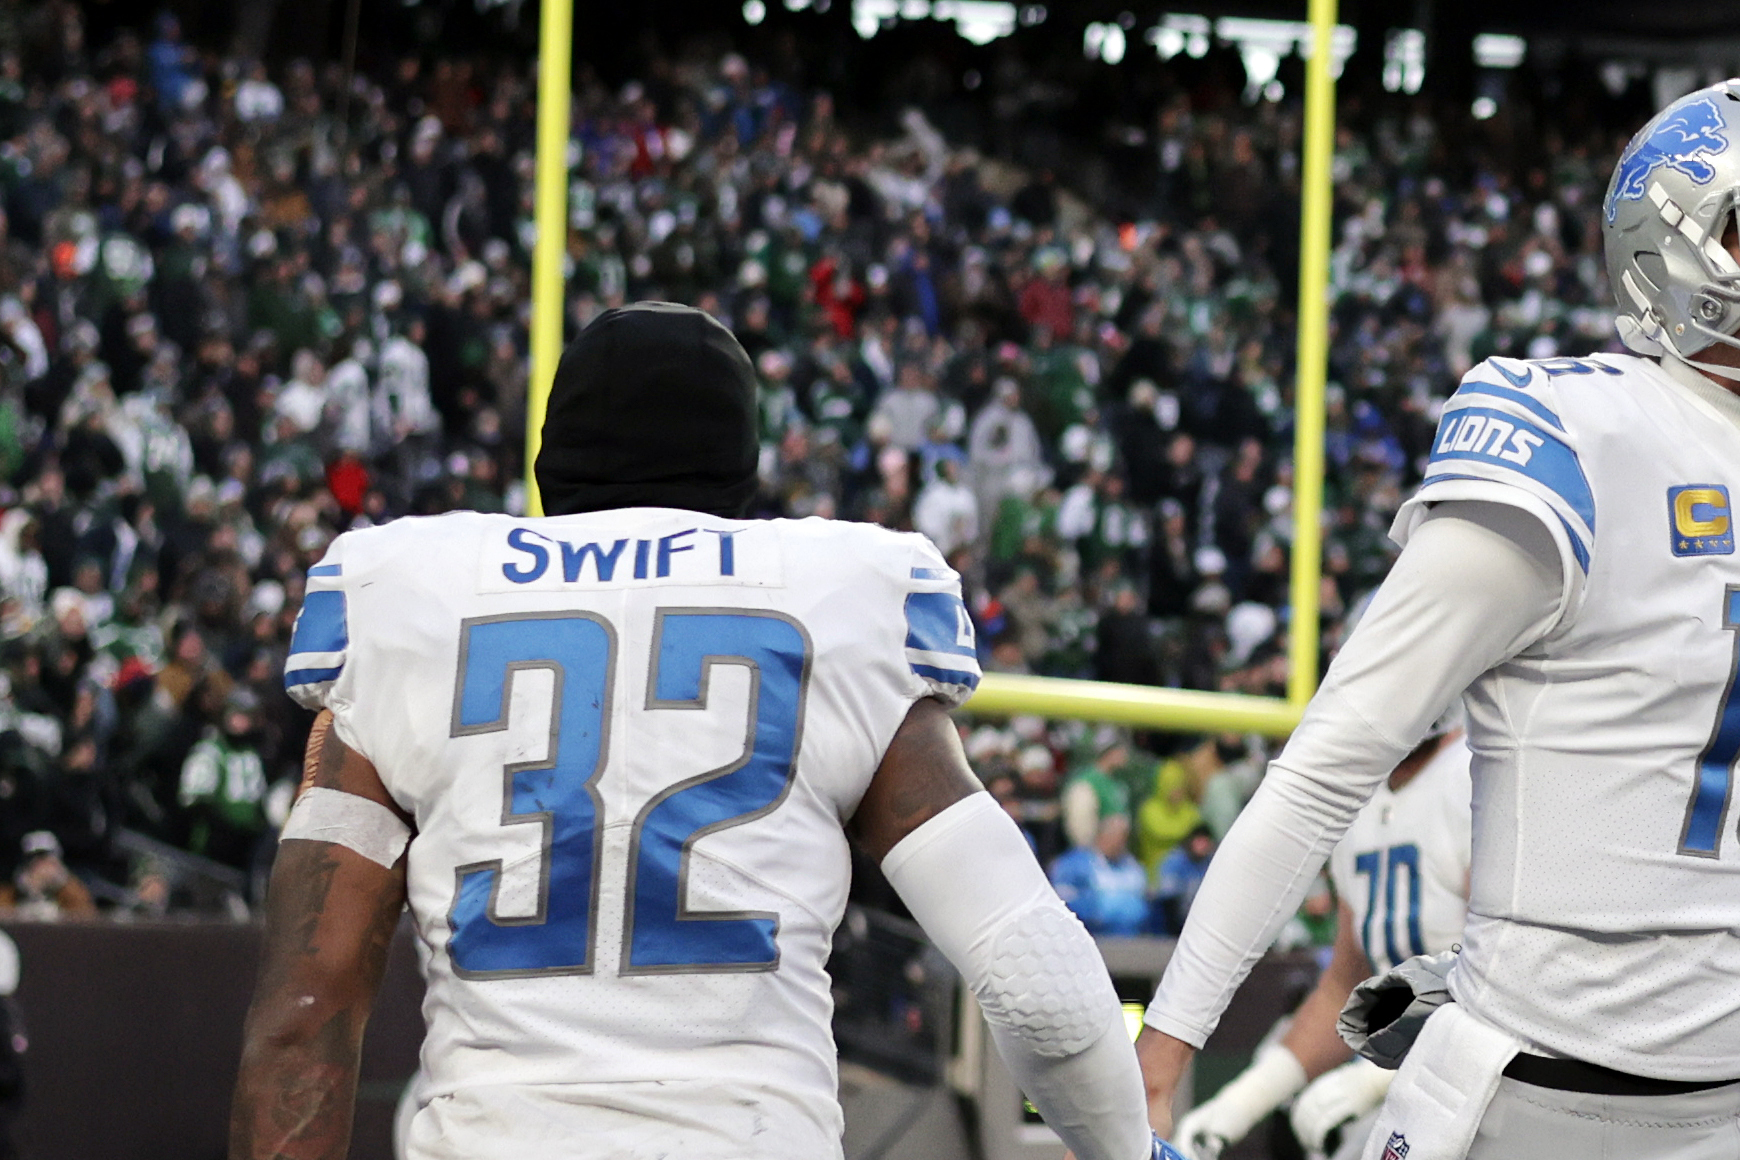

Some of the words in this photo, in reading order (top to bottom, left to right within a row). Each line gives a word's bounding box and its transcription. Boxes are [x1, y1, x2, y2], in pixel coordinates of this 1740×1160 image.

[1437, 416, 1545, 467] LIONS
[1675, 489, 1729, 537] C
[502, 528, 748, 584] SWIFT
[445, 606, 814, 981] 32
[1355, 844, 1426, 978] 70
